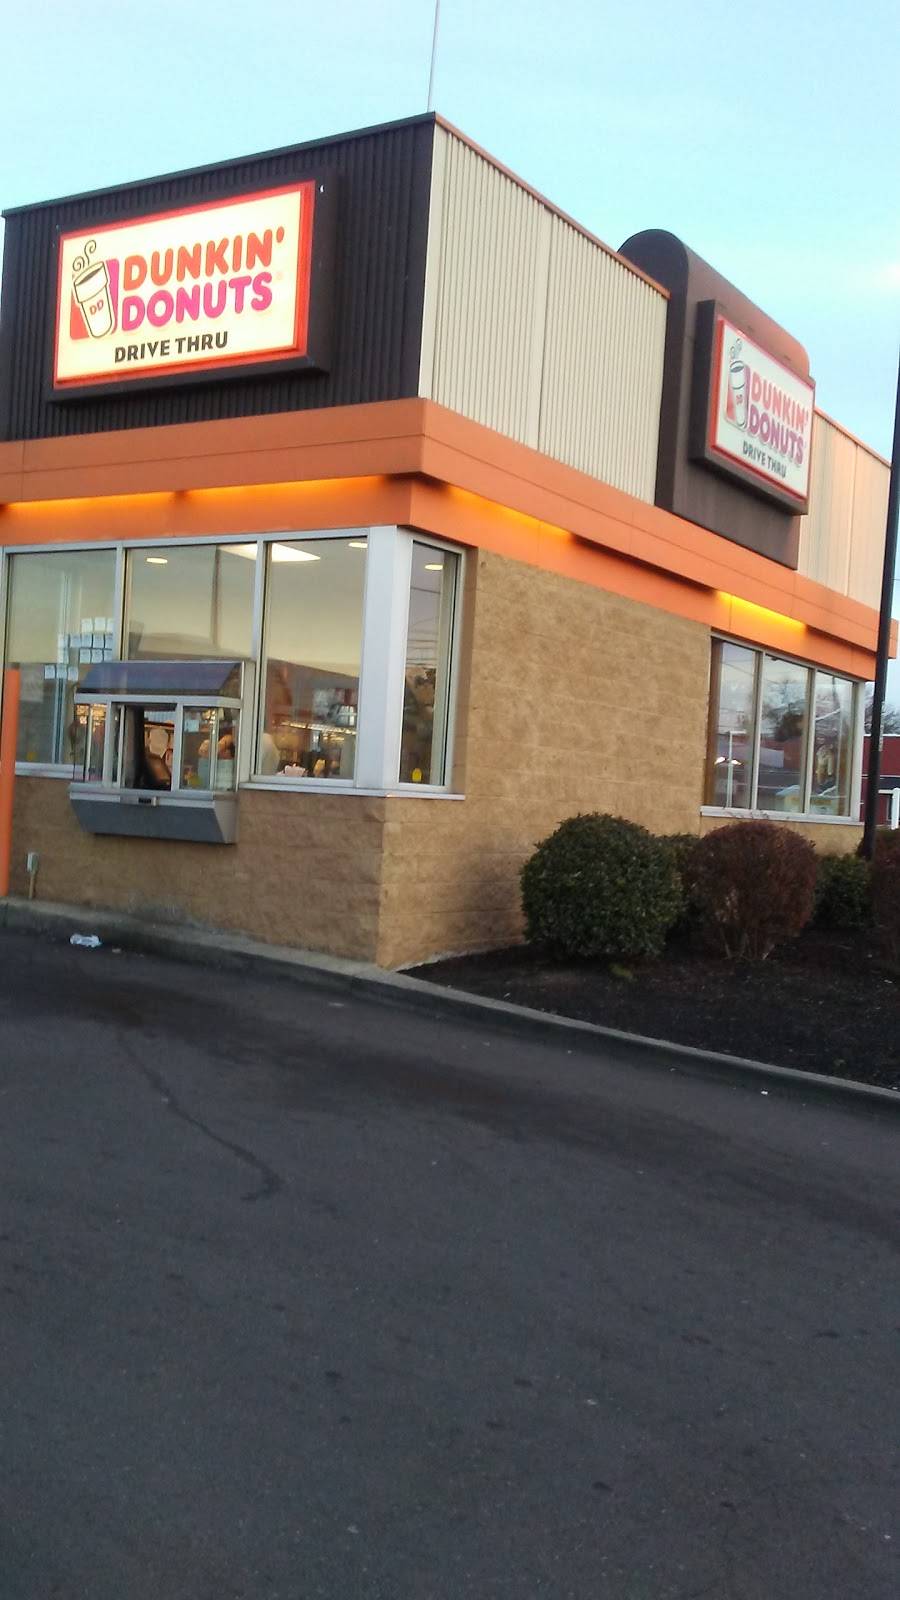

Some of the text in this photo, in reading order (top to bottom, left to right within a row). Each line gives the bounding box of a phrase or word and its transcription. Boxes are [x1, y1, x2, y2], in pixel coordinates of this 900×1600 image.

[123, 226, 285, 291] DUNKIN'
[121, 271, 273, 332] DONUTS
[114, 331, 229, 363] DRIVE THRU
[751, 372, 809, 434] DUNKIN'
[743, 440, 788, 479] DRIVE THRU
[749, 404, 804, 465] DONUTS
